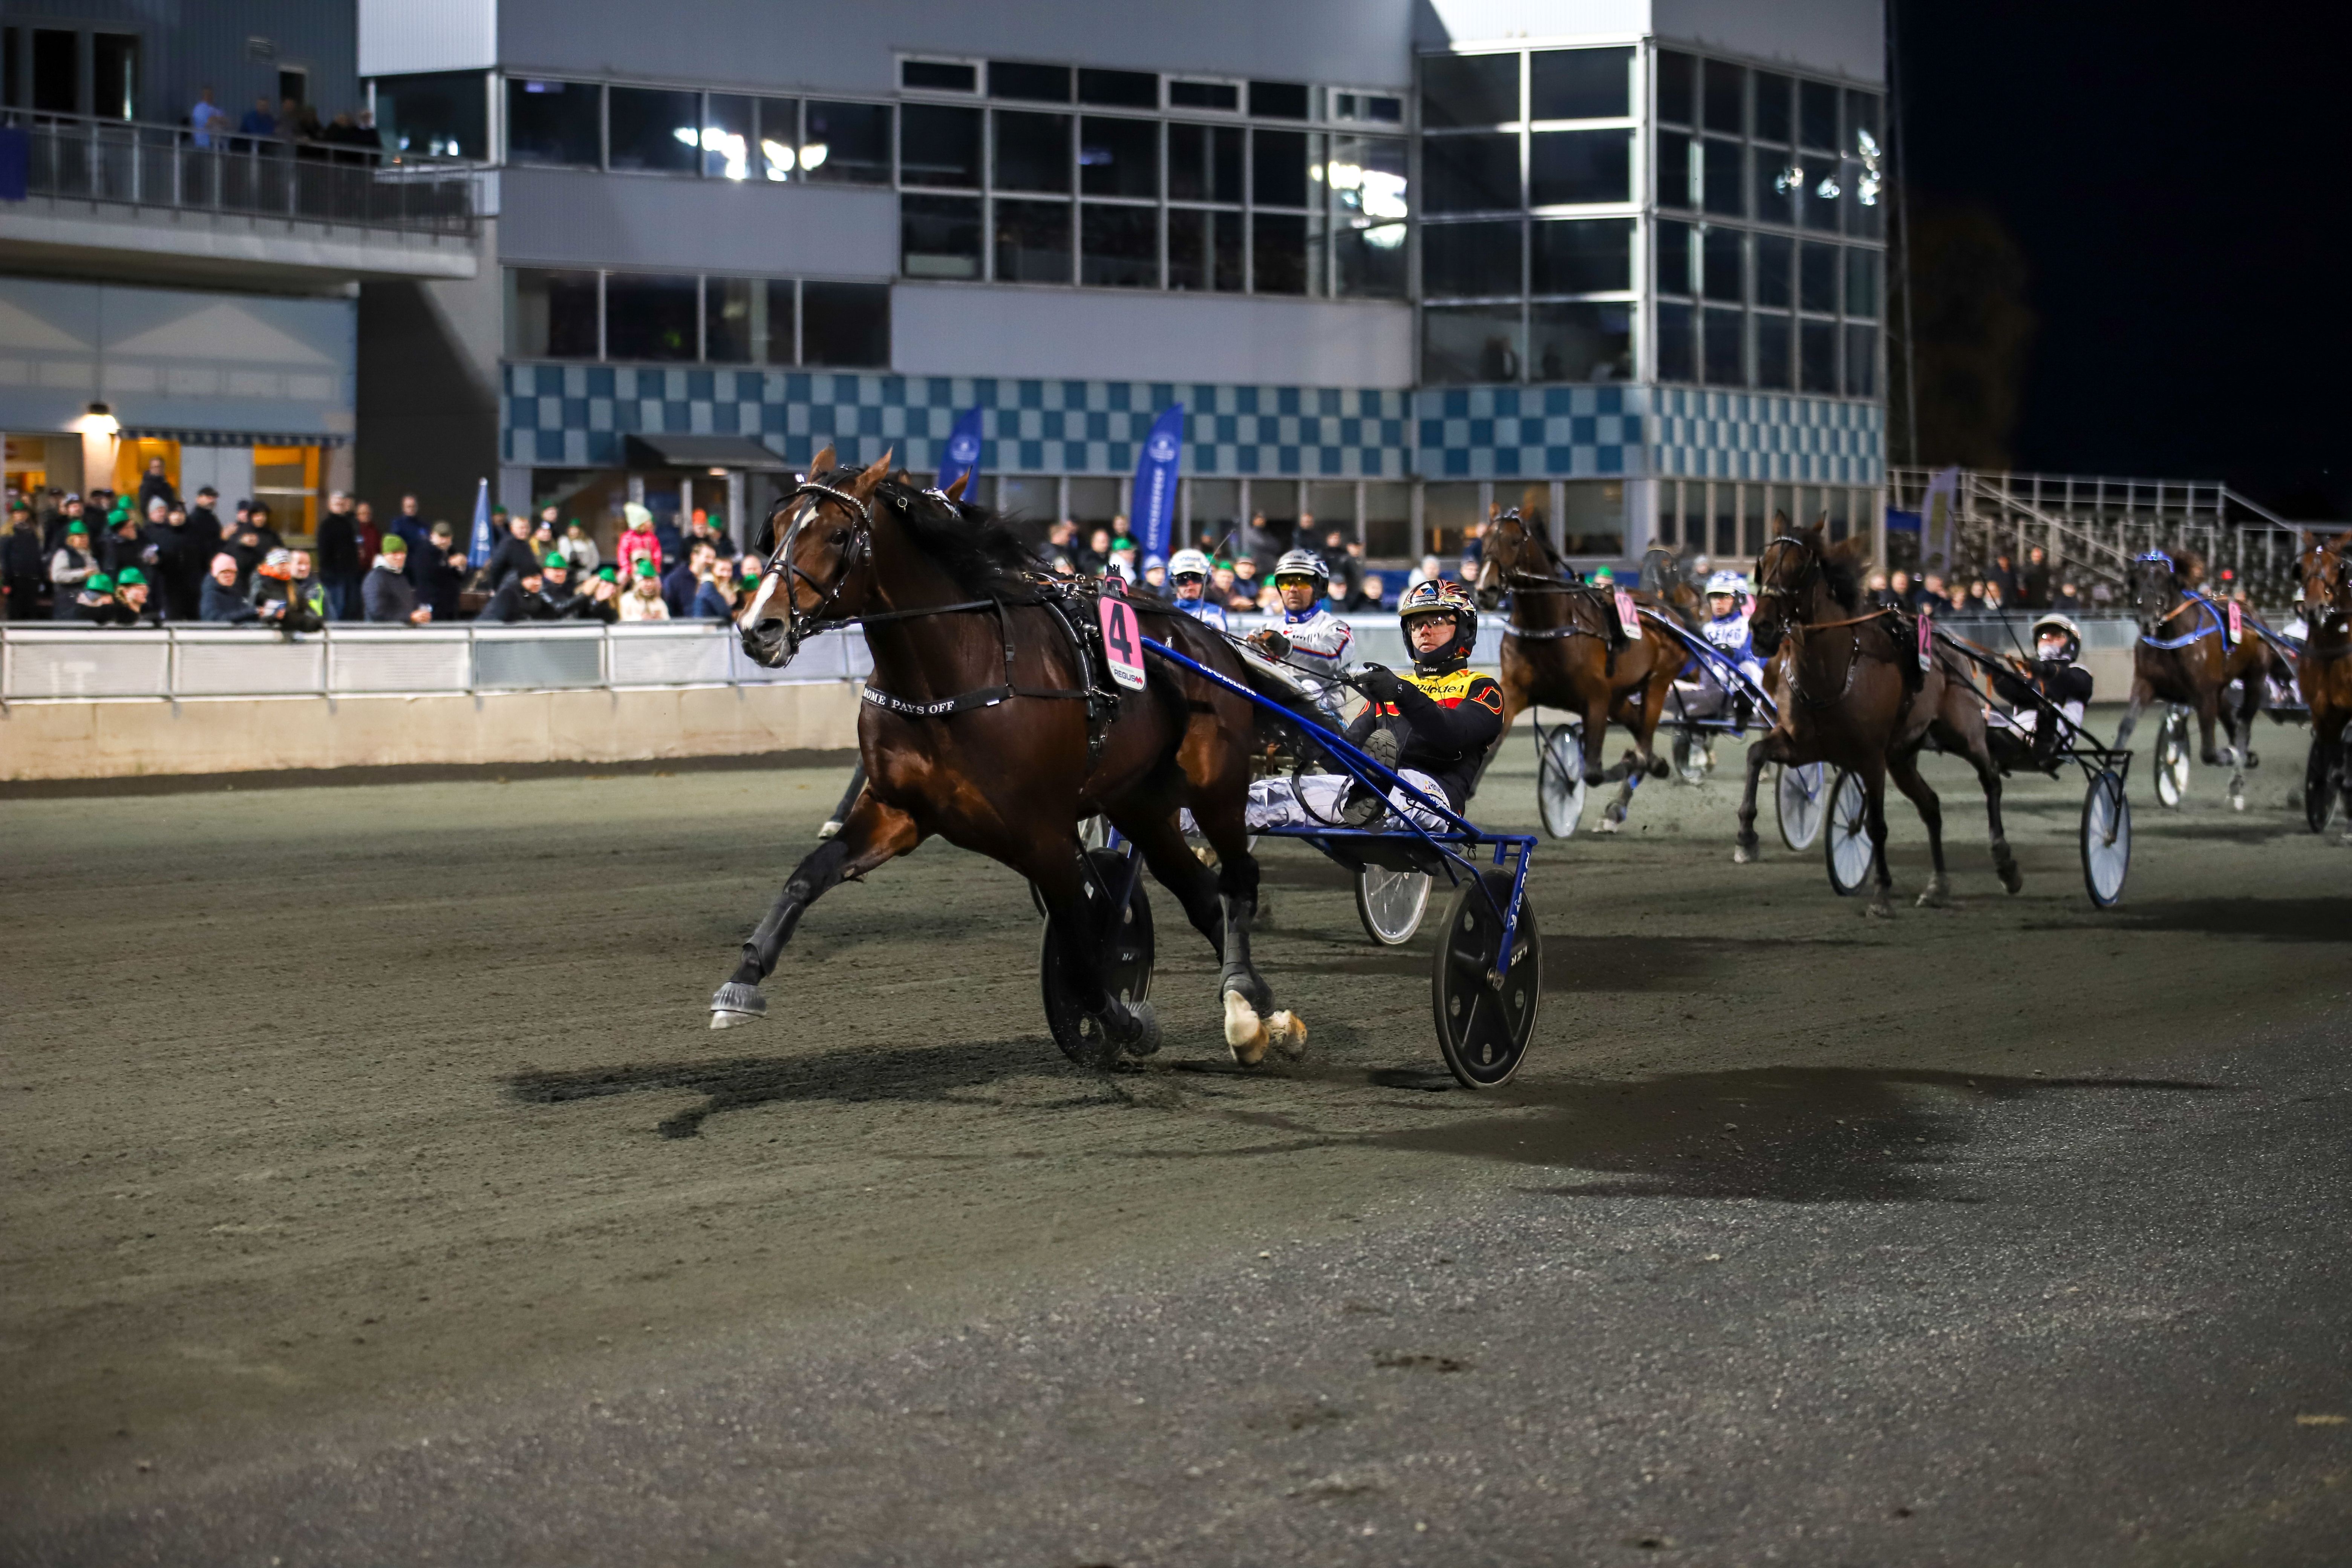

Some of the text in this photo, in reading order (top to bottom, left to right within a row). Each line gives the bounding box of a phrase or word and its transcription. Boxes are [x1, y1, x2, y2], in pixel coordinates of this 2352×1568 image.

[1618, 596, 1638, 626] 12
[1109, 603, 1133, 665] 4
[863, 688, 954, 714] ROME PAYS OFF
